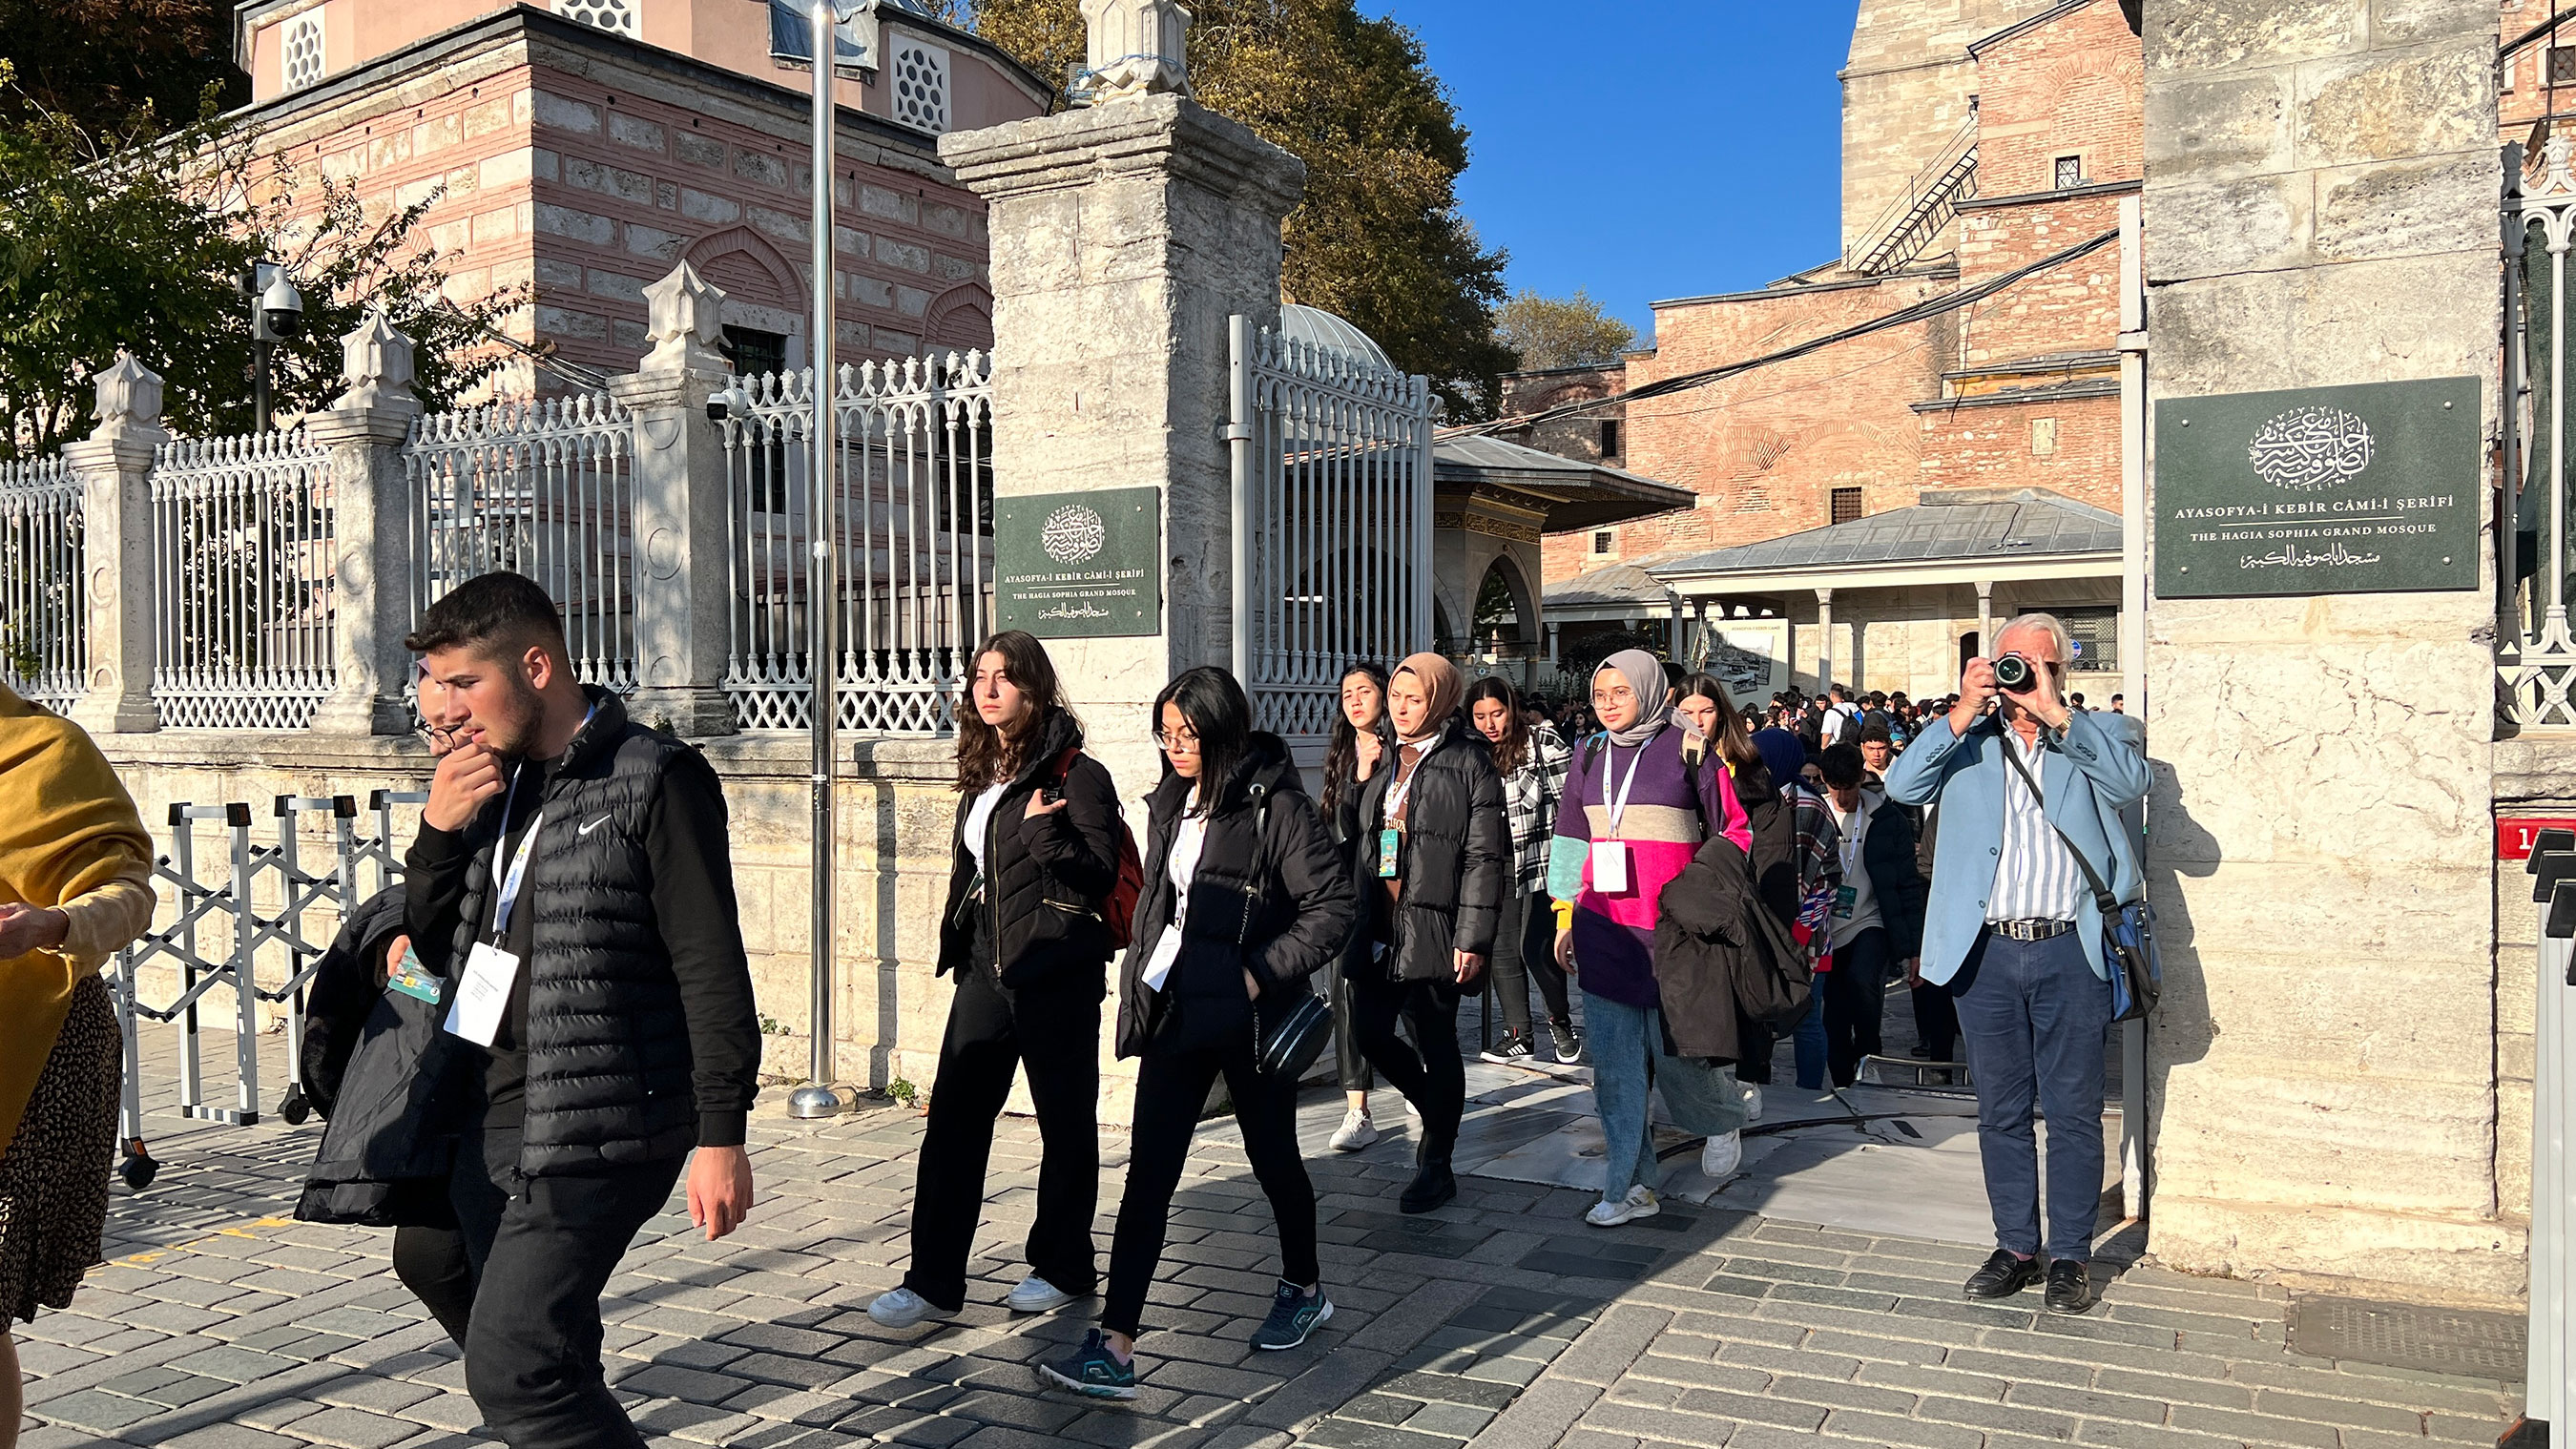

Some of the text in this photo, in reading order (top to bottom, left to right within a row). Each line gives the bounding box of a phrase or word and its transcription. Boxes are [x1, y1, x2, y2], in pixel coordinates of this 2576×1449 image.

[2190, 524, 2437, 542] THE HAGIA SOPHIA GRAND MOSQUE
[1079, 590, 1105, 598] GRAND
[1106, 589, 1136, 597] MOSQUE
